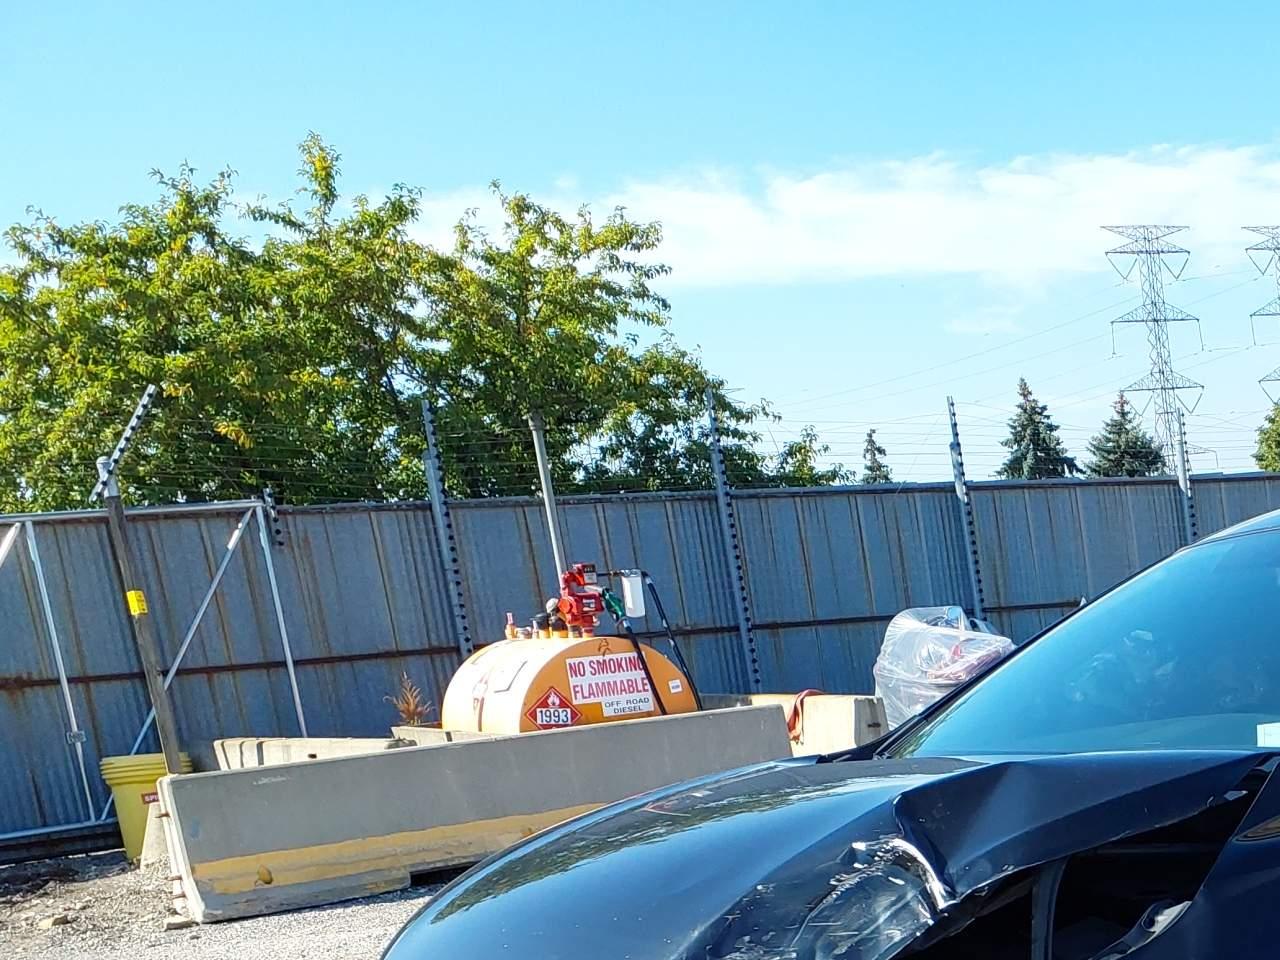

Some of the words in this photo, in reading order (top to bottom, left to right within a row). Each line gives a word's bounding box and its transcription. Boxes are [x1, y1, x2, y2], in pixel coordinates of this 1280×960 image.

[568, 661, 586, 678] NO
[572, 677, 649, 700] FLAMMABLE
[604, 700, 621, 708] OFF
[626, 697, 650, 705] ROAD
[613, 705, 643, 714] DIESEL
[539, 709, 569, 723] 1993
